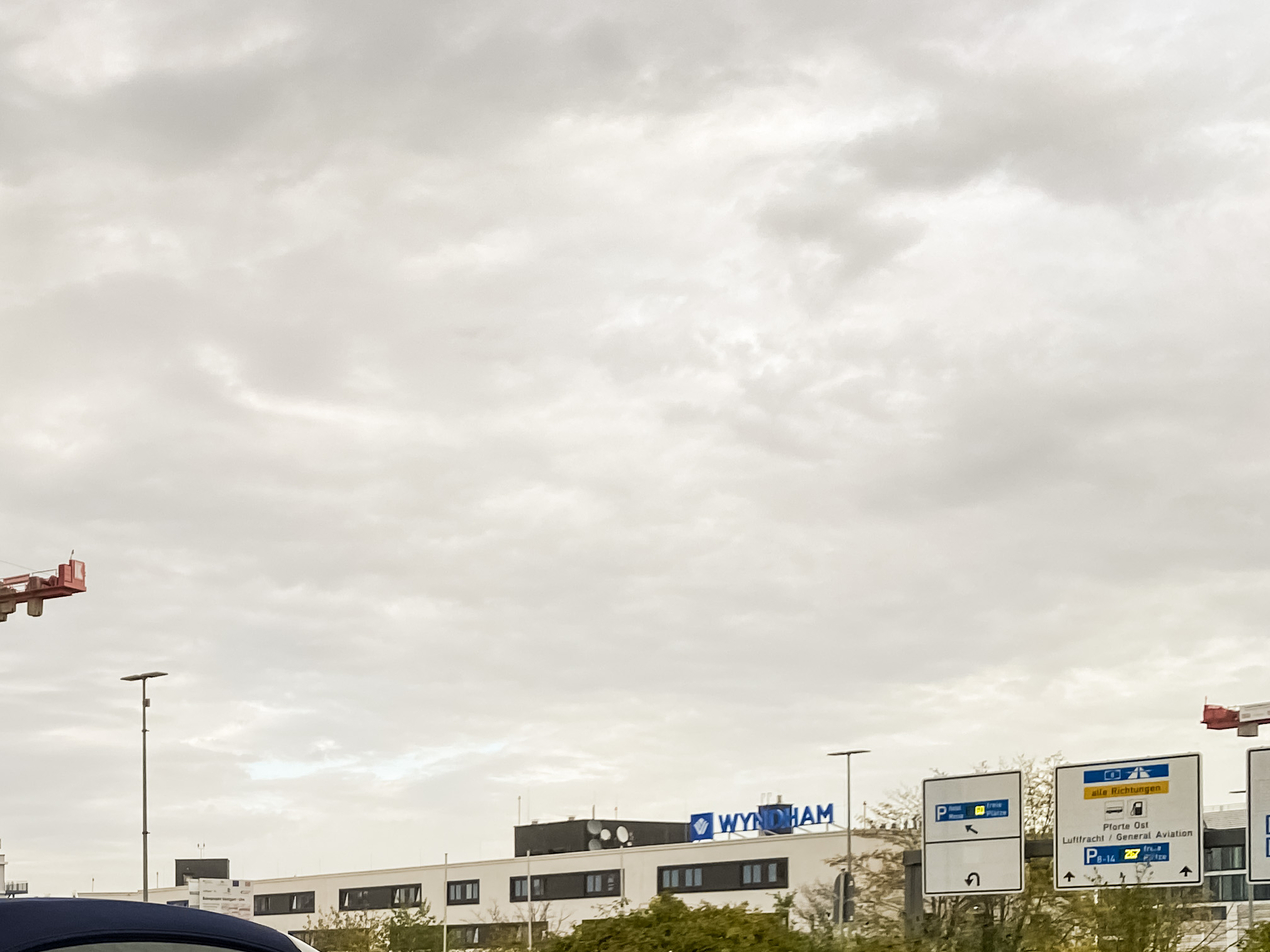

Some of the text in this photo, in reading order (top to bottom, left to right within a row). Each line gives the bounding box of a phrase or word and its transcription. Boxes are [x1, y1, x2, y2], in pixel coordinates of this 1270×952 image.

[1091, 784, 1161, 797] alle Richtungen
[718, 803, 834, 833] WYNDHAM
[937, 805, 947, 821] P
[1103, 821, 1149, 832] Pforte Ost
[1062, 834, 1105, 845] Luftfracht
[1116, 831, 1151, 841] General
[1155, 829, 1193, 839] Aviation
[1086, 848, 1098, 864] P
